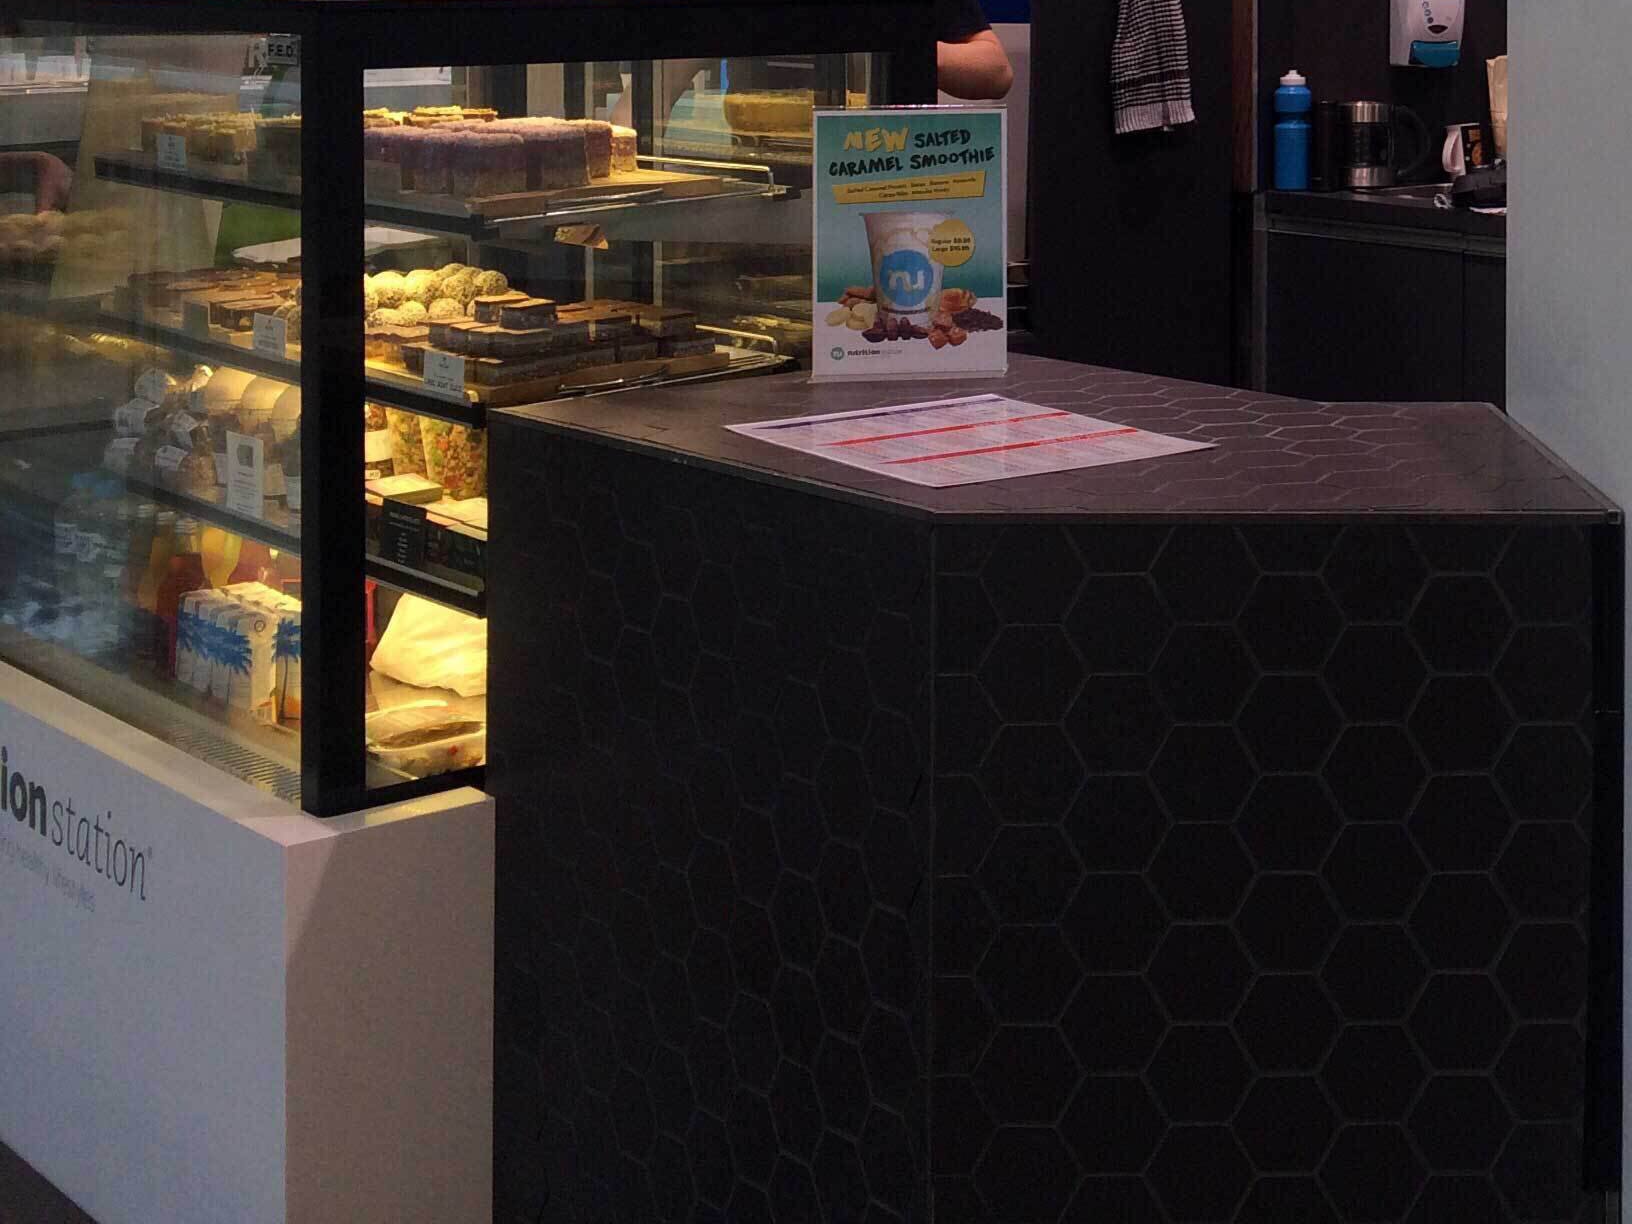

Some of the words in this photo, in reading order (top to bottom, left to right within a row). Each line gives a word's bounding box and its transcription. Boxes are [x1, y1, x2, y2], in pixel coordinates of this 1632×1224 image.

[843, 126, 909, 152] NEW
[914, 129, 971, 148] SALTED
[828, 155, 904, 177] CARAMEL
[909, 146, 995, 170] SMOOTHIE
[889, 269, 926, 292] nu
[51, 797, 146, 901] station
